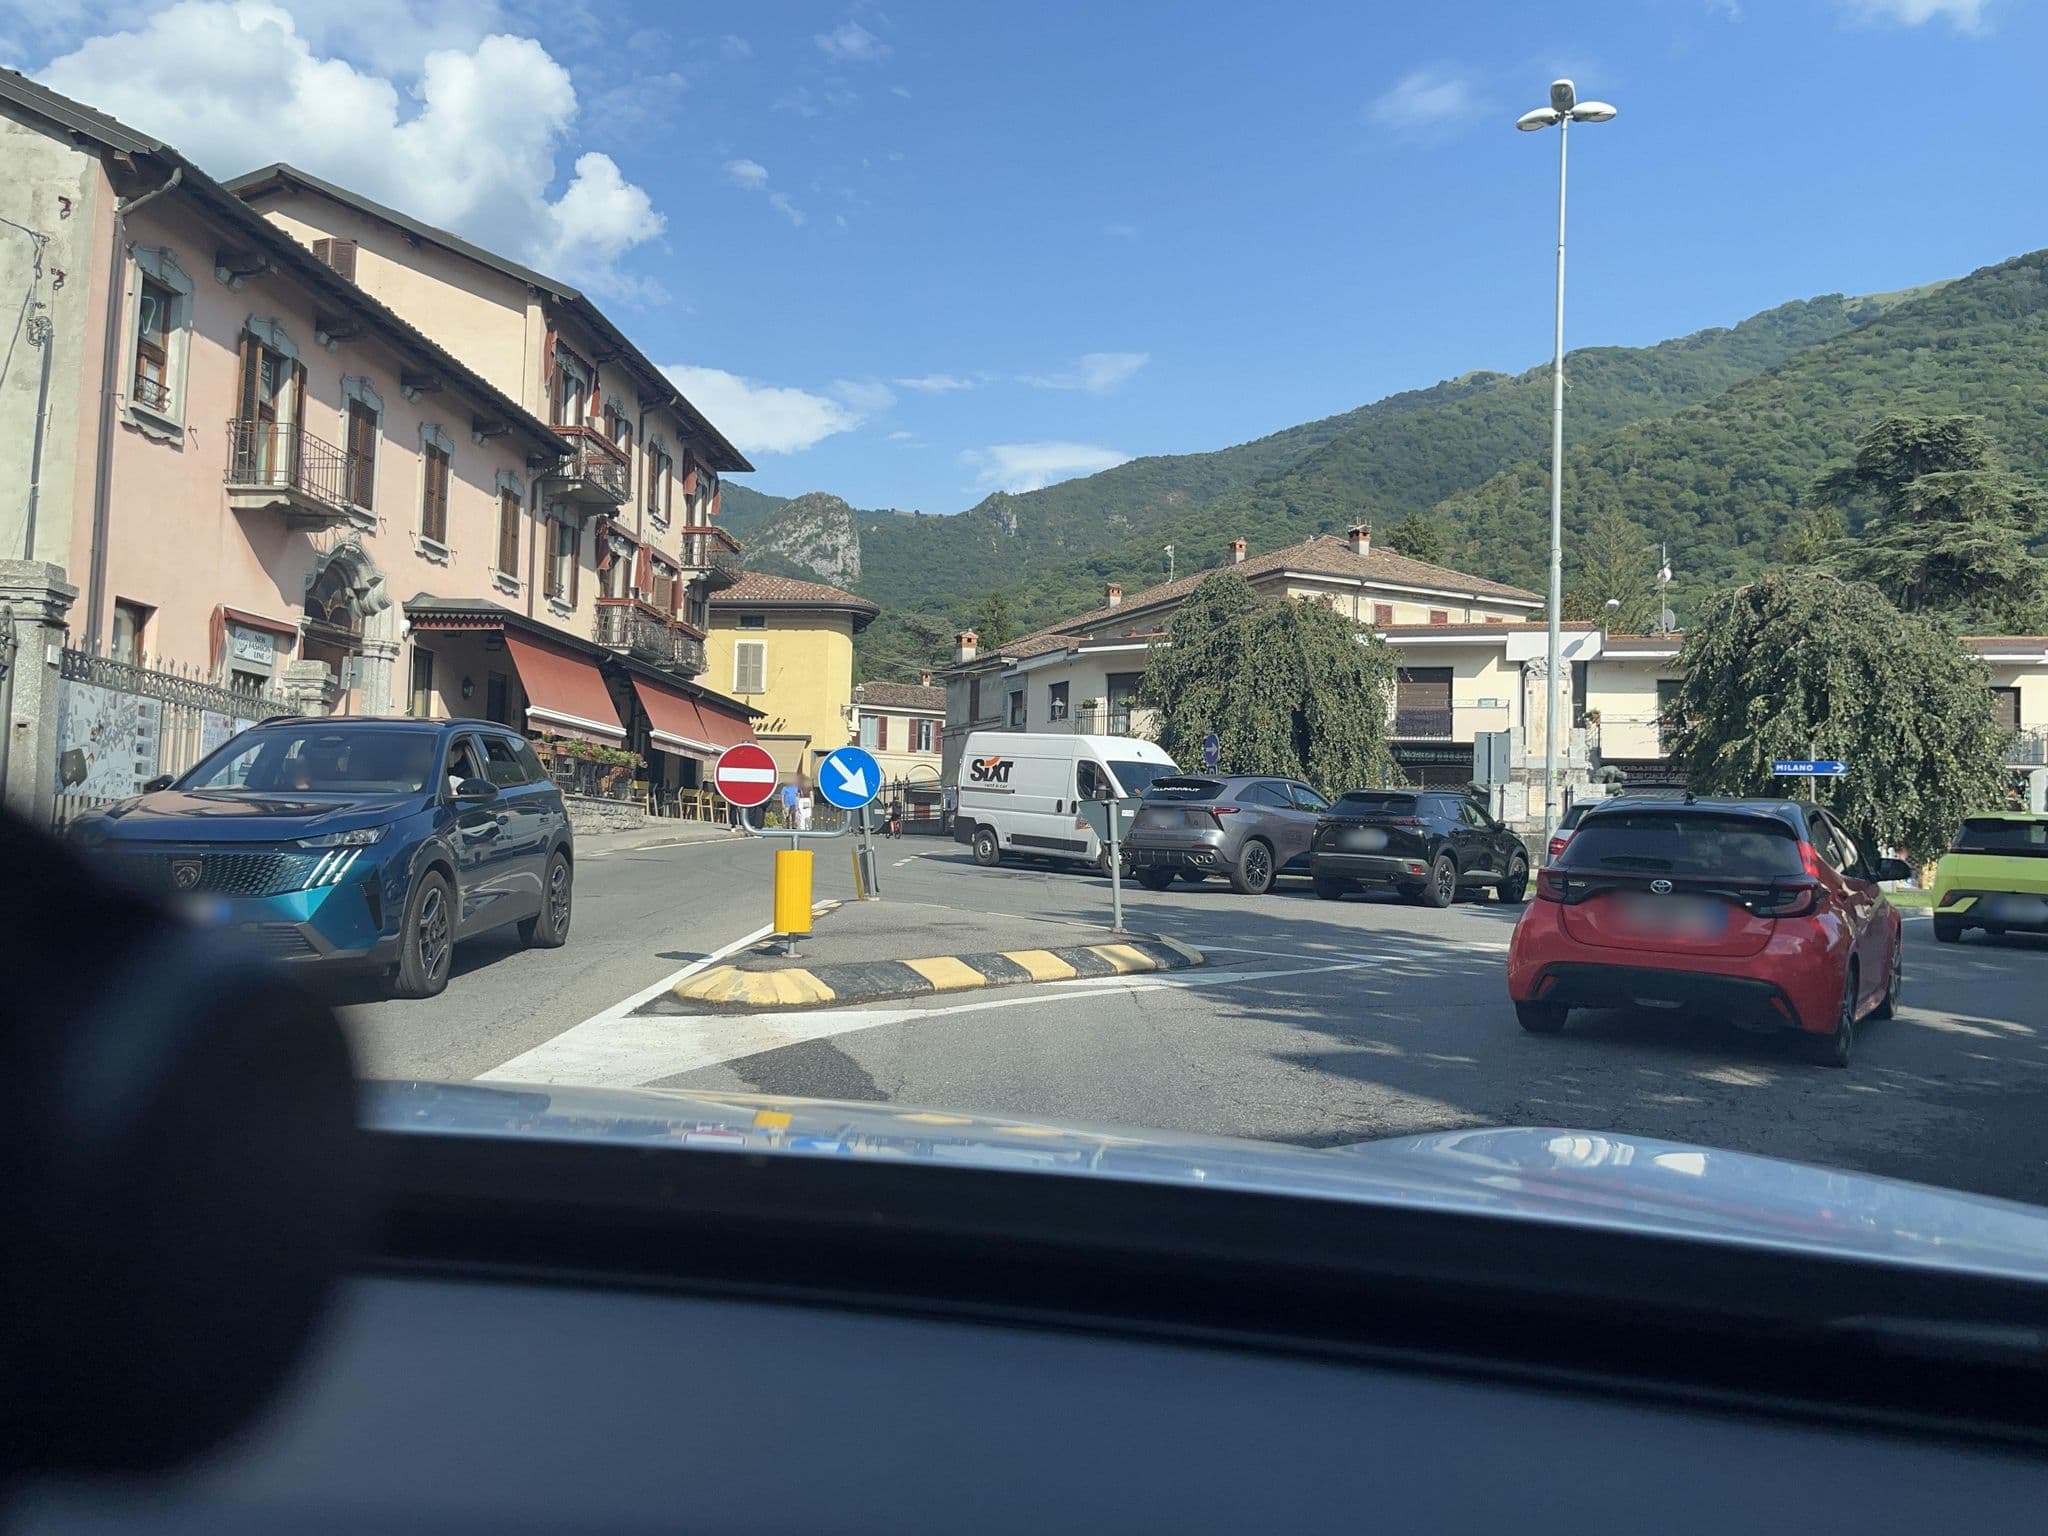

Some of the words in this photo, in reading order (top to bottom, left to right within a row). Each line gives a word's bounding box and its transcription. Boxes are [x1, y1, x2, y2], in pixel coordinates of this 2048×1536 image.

[254, 634, 266, 644] NEW
[248, 641, 271, 653] FASHION
[253, 651, 265, 660] LINE
